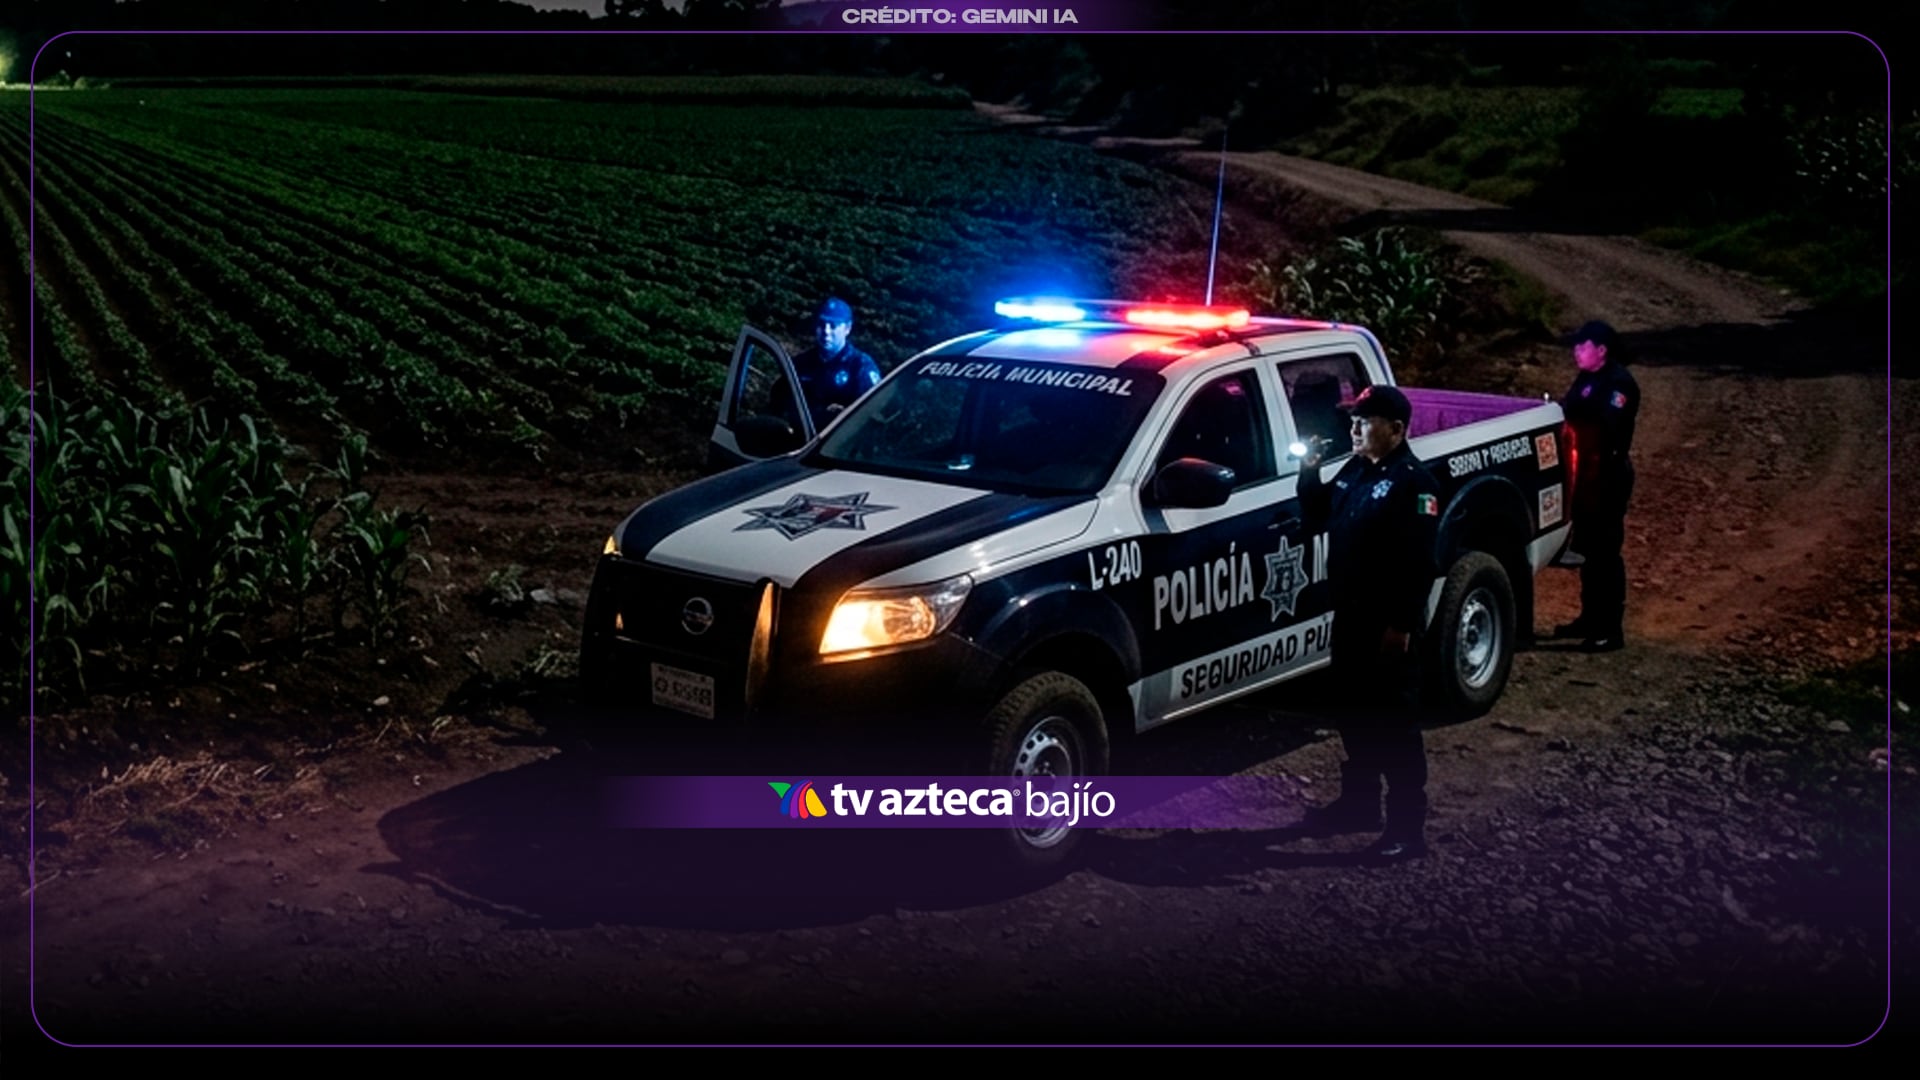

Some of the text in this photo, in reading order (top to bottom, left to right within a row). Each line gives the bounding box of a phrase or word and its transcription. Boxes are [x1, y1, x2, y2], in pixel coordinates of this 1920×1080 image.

[1004, 367, 1133, 396] MUNICIPAL
[1153, 541, 1255, 631] POLICÍA
[1180, 634, 1298, 699] SEGURIDAD
